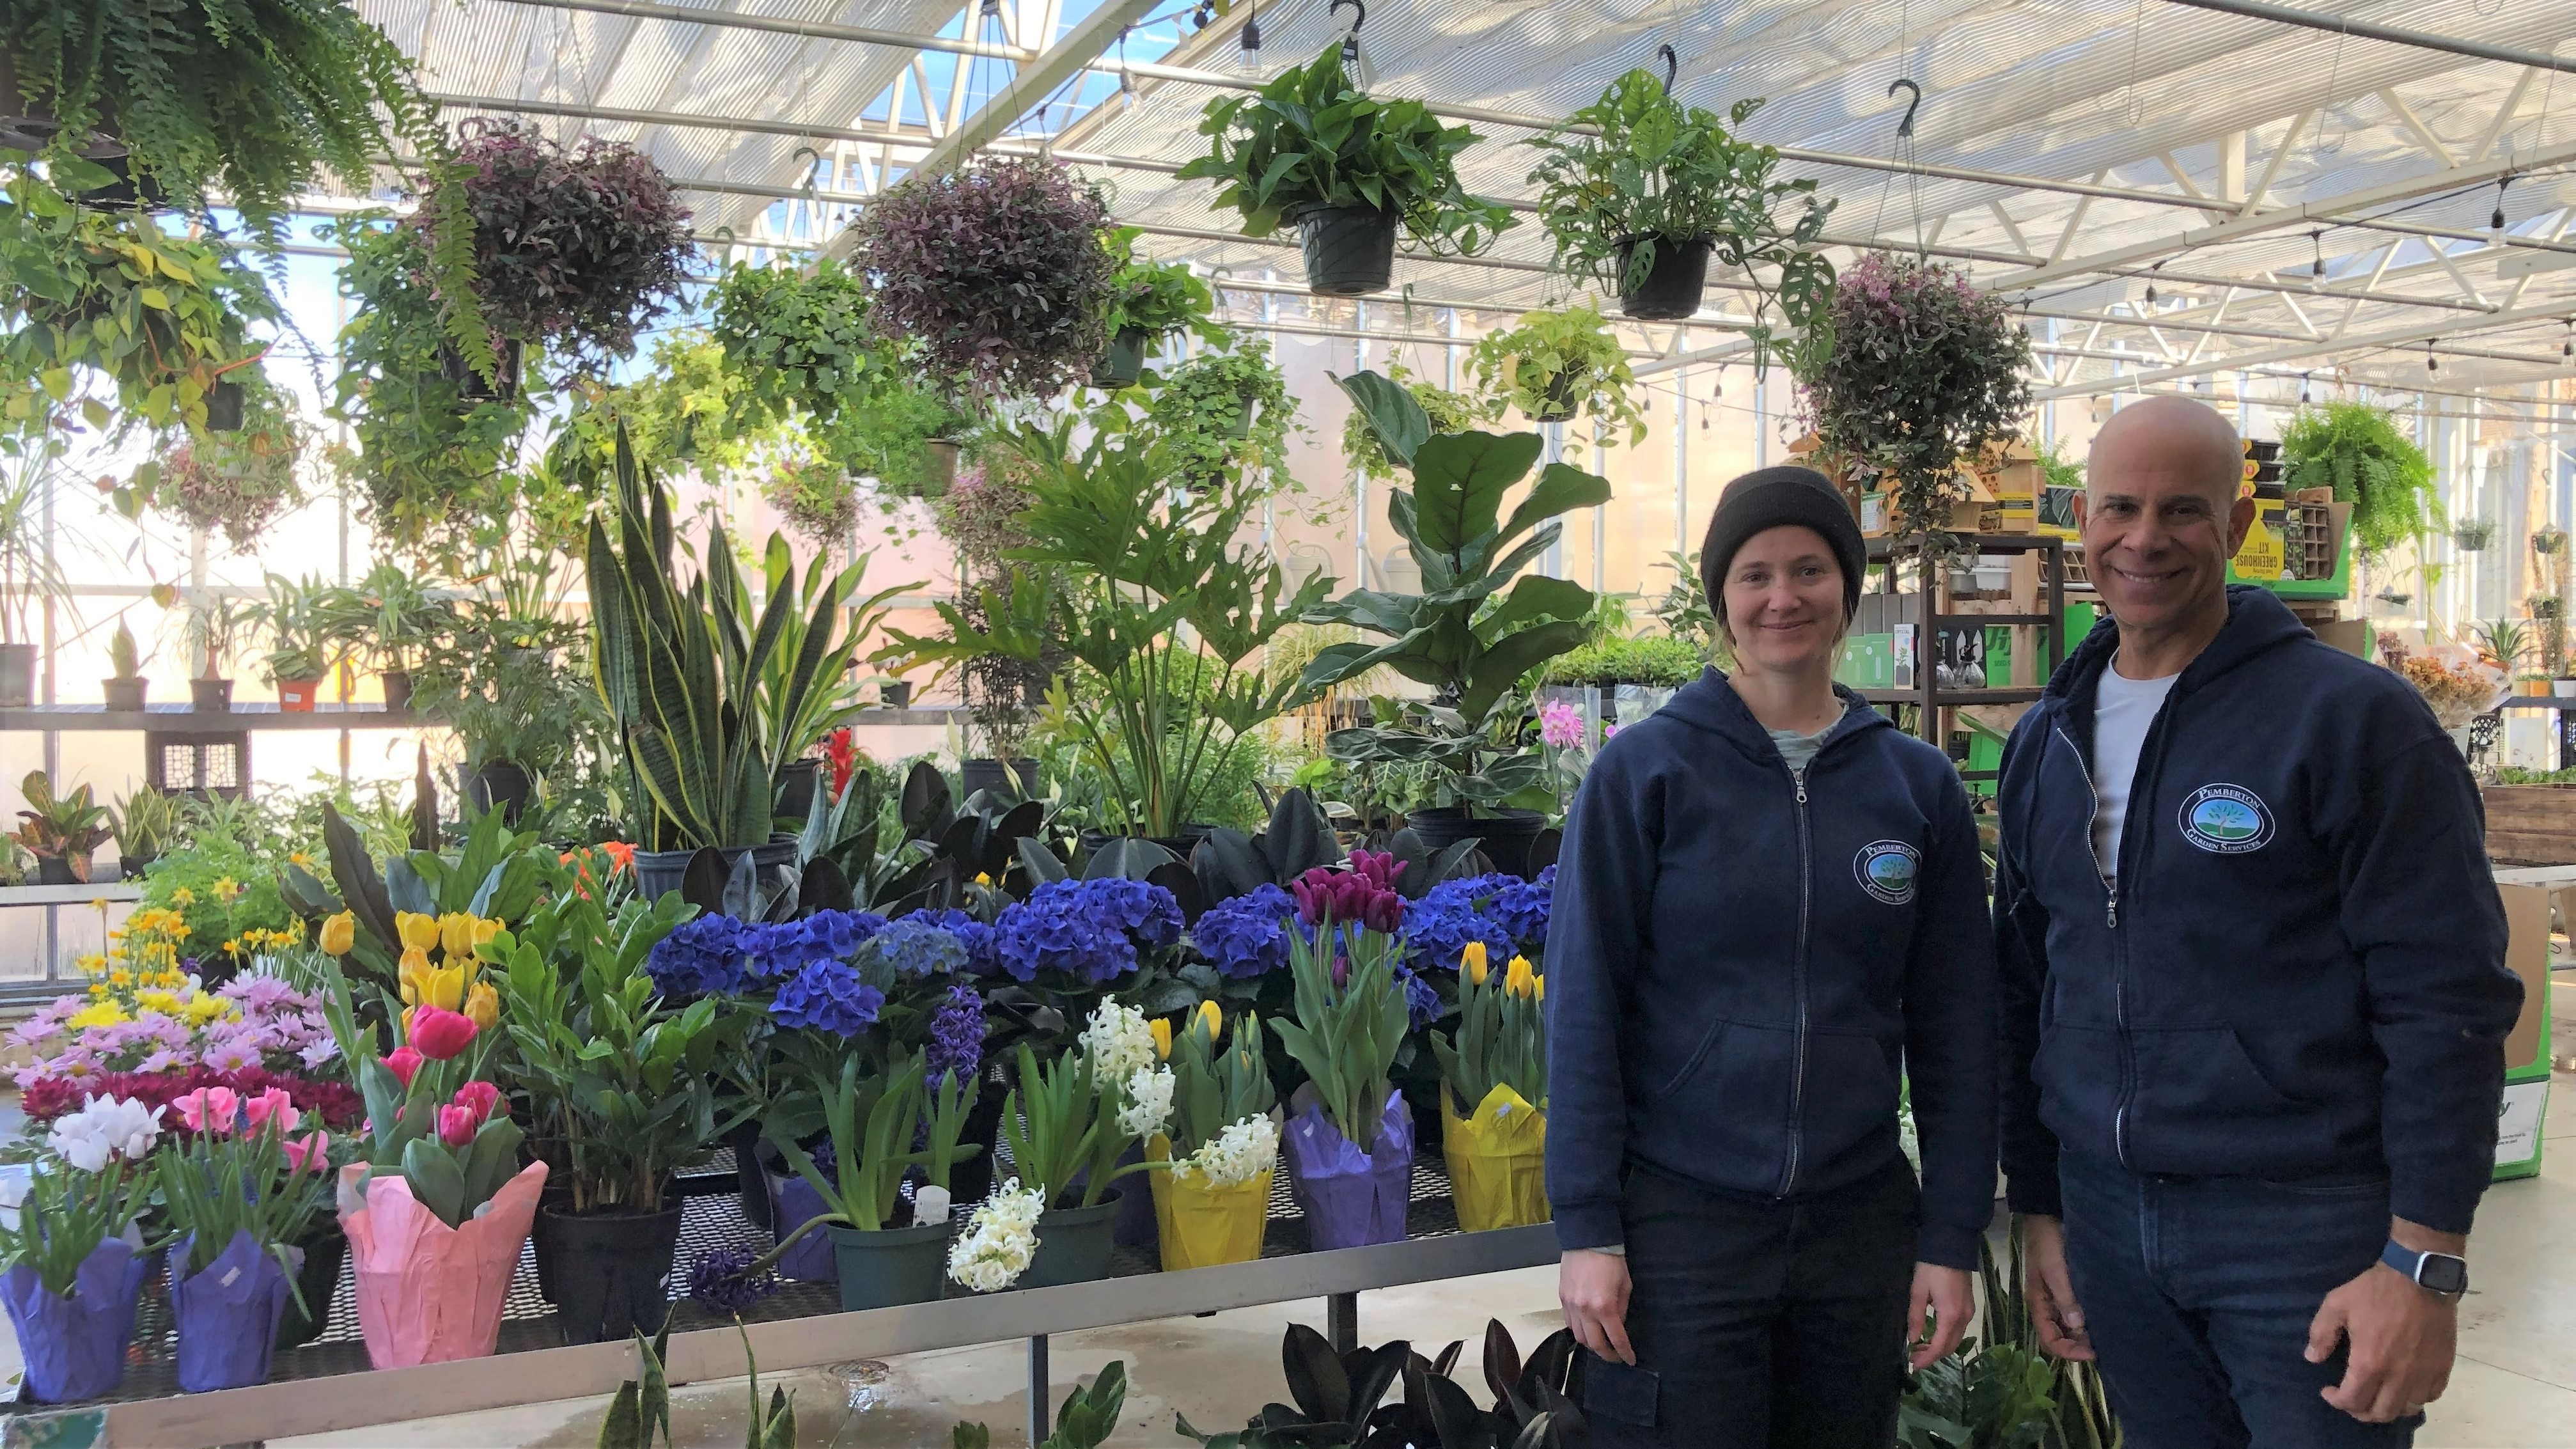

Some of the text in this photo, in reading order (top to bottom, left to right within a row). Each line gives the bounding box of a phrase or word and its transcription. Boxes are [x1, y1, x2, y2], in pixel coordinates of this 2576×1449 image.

[2259, 542, 2269, 554] KIT
[2236, 554, 2277, 568] GREENHOUSE
[2198, 788, 2260, 809] PEMBERTON
[2187, 828, 2261, 851] GARDEN SERVICES
